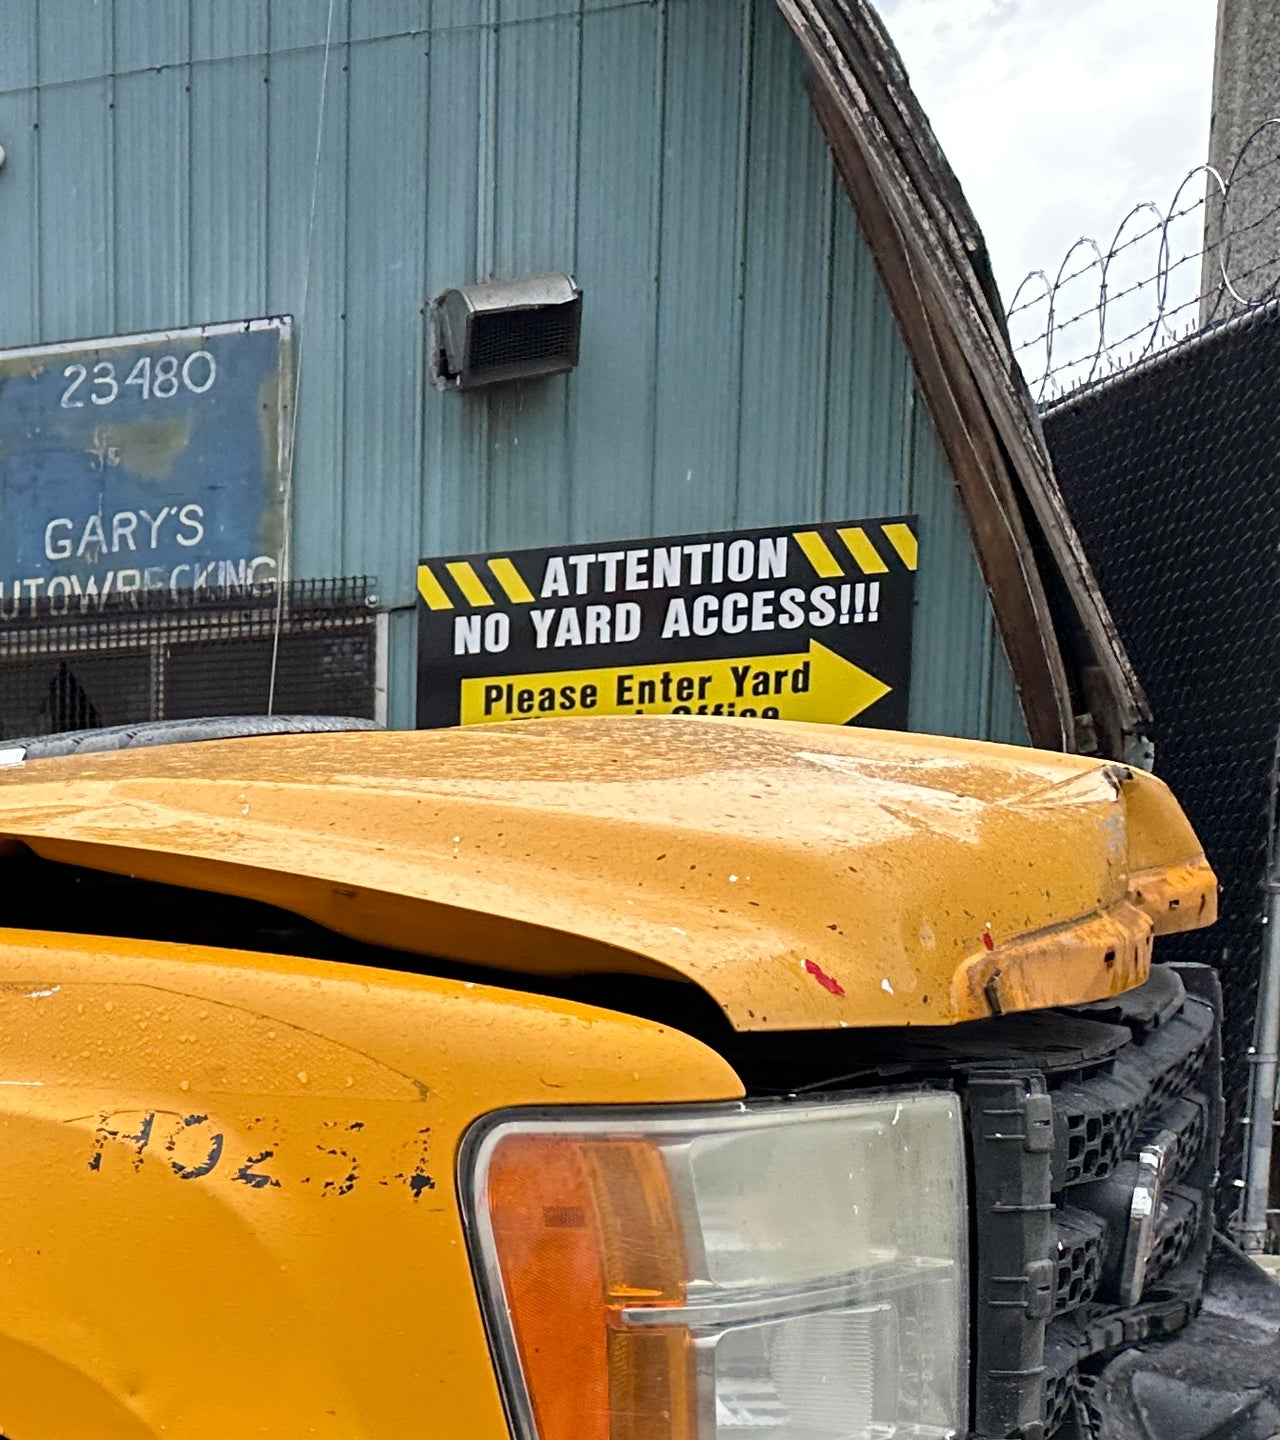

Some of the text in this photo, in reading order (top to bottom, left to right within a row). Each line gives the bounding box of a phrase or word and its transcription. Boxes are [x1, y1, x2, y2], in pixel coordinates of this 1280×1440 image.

[60, 350, 217, 409] 23480
[44, 503, 205, 561] GARY'S
[540, 536, 788, 599] ATTENTION
[453, 581, 881, 656] NO YARD ACCESS!!!
[483, 660, 811, 716] Please Enter Yard
